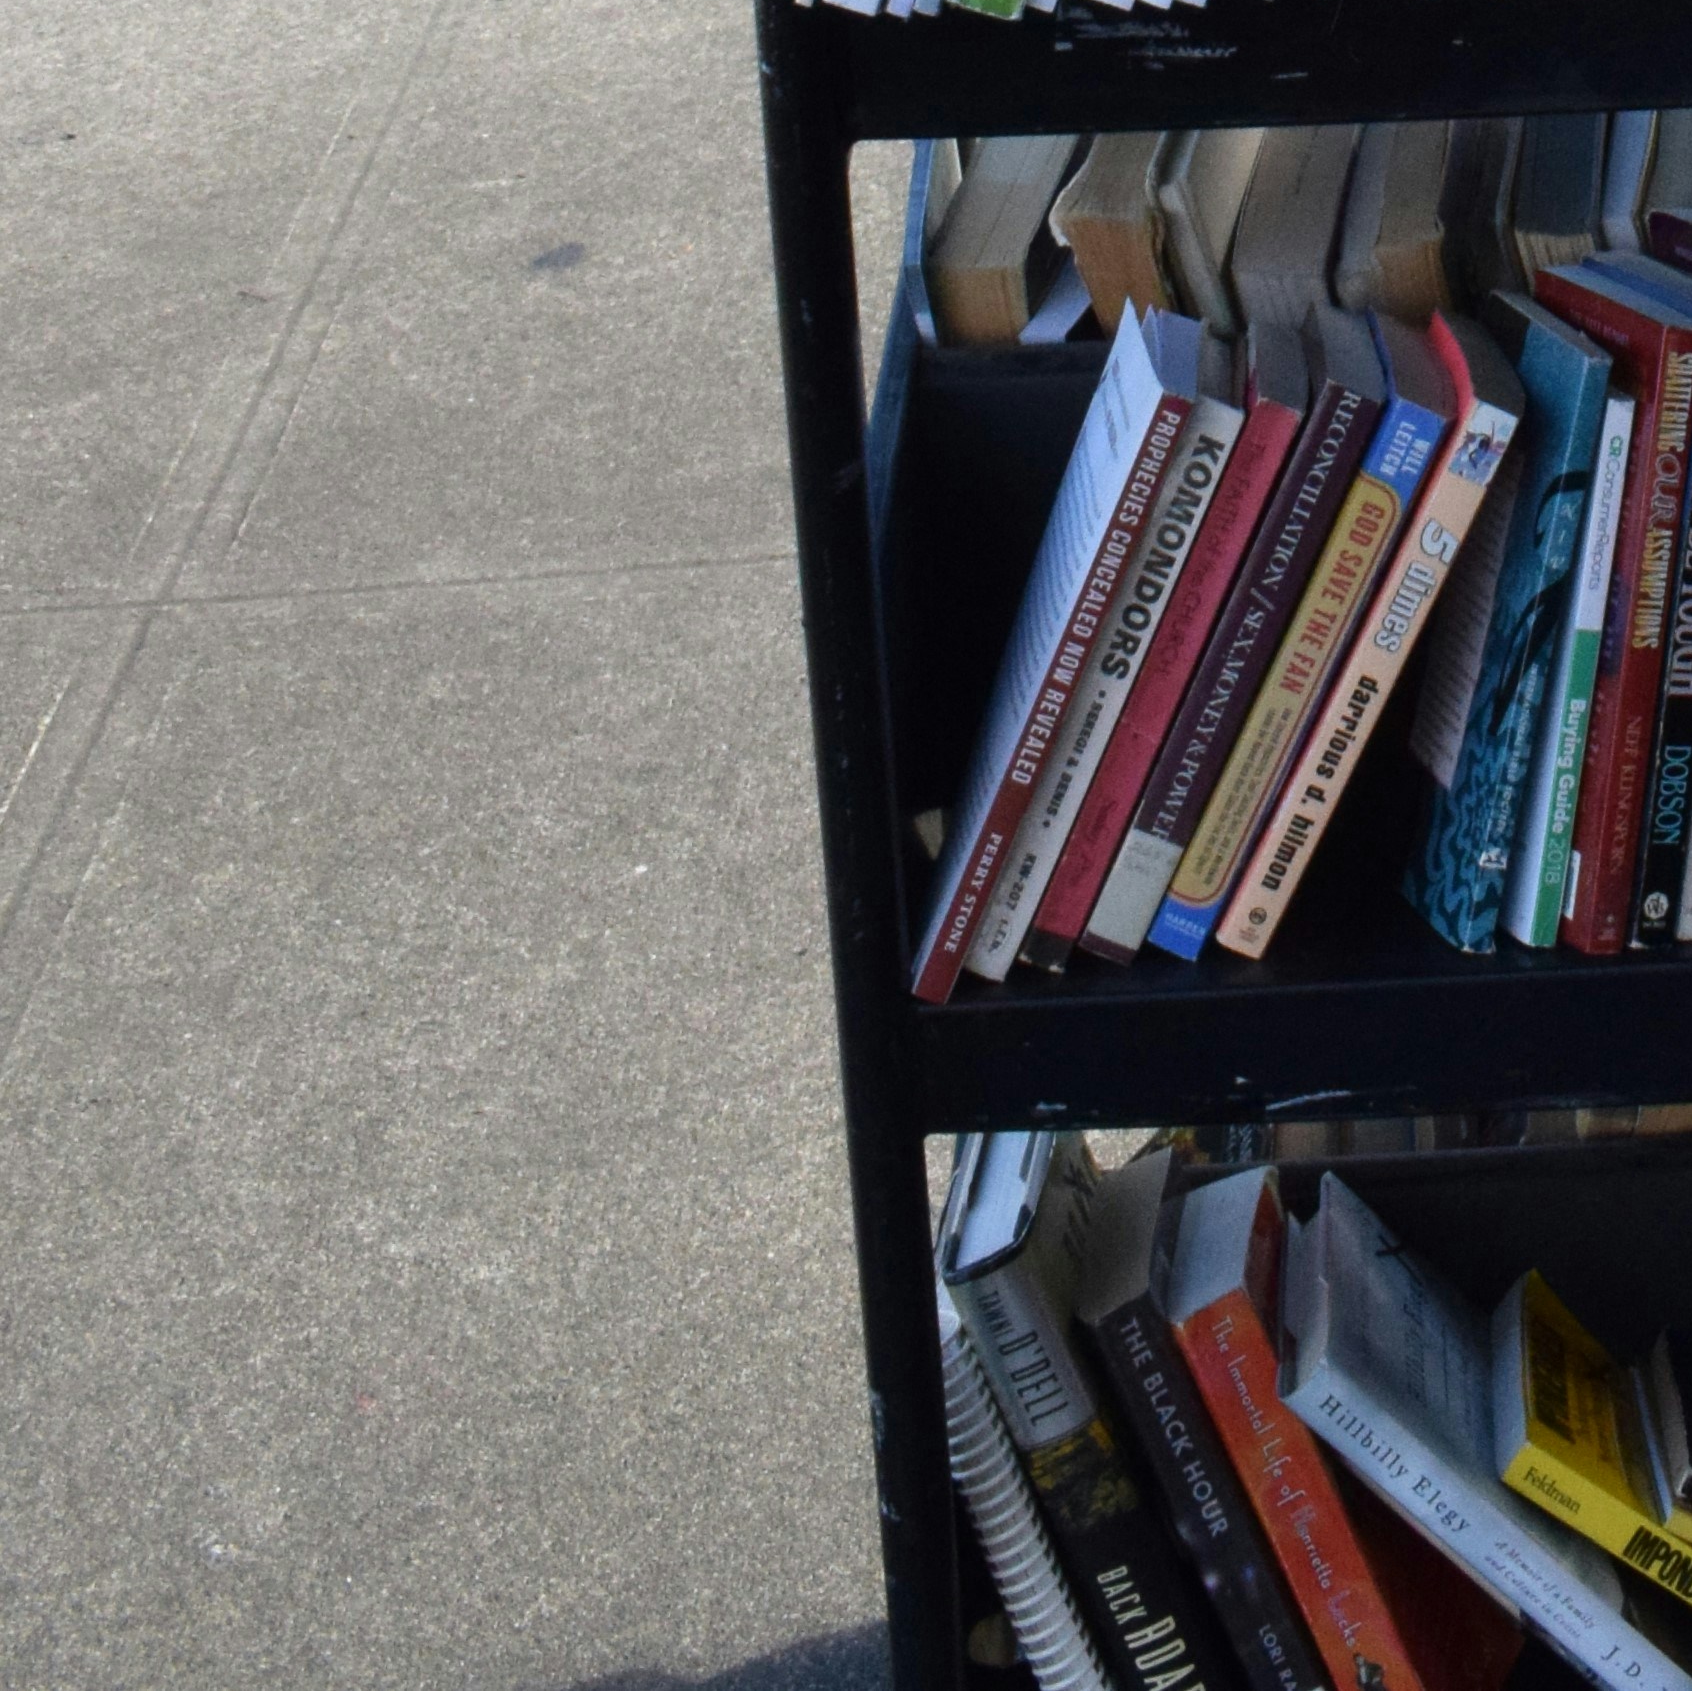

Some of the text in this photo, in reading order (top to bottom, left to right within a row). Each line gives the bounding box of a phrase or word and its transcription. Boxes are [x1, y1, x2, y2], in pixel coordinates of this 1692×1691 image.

[1378, 419, 1416, 477] LEITCH
[1400, 436, 1429, 476] WILL
[1009, 408, 1179, 786] PROPHECIES CONCEALED NOW REVEALED
[1097, 432, 1226, 684] KOMONDORS
[1278, 500, 1386, 696] GOD SAVE THE FAN
[1260, 517, 1463, 894] 5 dimes darrious d. hilmon
[1543, 697, 1586, 885] Buying Guide 2018
[1651, 744, 1691, 846] DOBSON
[942, 831, 1002, 954] PERRY STONE
[1114, 1316, 1233, 1537] THE BLACK HOUR
[1206, 1314, 1370, 1648] The Immortal Life of Henrietta Lacks
[1314, 1393, 1475, 1537] Hillbilly Elegy
[1521, 1464, 1584, 1516] Feldman
